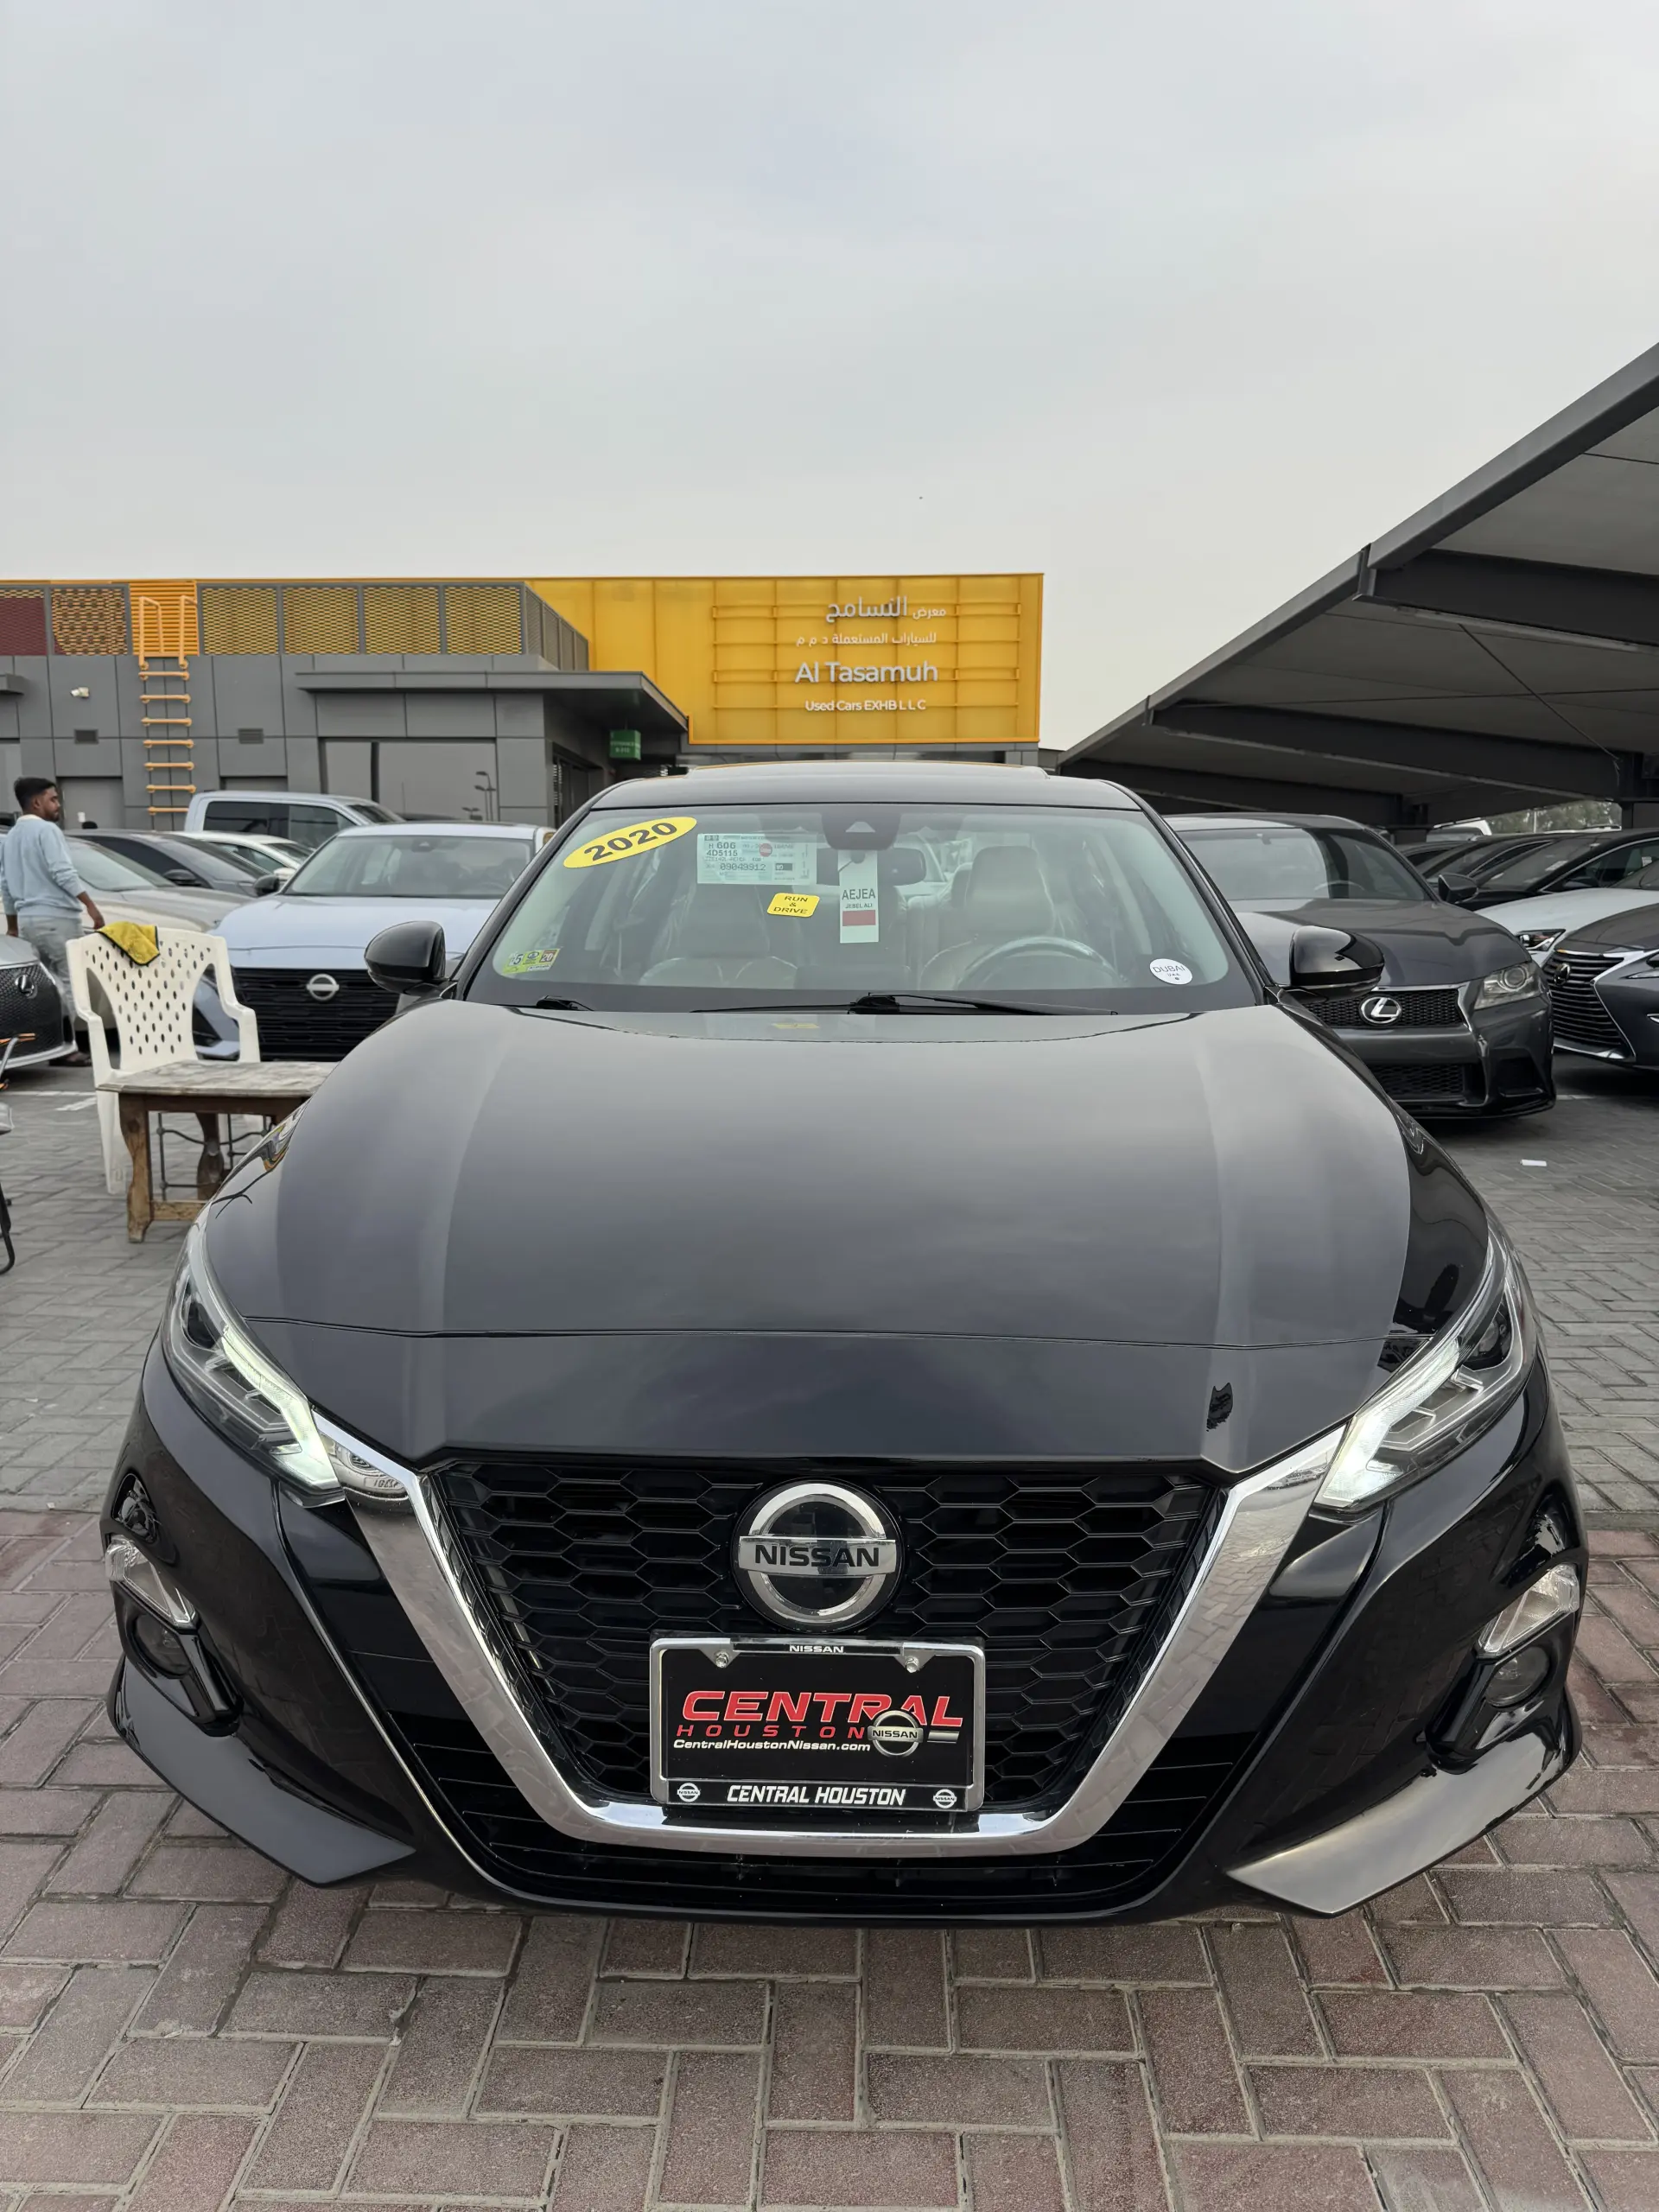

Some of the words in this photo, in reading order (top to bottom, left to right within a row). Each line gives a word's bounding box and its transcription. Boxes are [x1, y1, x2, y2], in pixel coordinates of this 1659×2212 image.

[826, 596, 907, 622] التسامح
[912, 607, 946, 620] معرض
[796, 636, 805, 647] م
[808, 636, 817, 647] م
[832, 632, 888, 645] المستعملة
[892, 632, 937, 646] للسيارات
[795, 662, 819, 683] Al
[825, 661, 938, 682] Tasamuh
[805, 700, 835, 711] Used
[836, 700, 862, 711] Cars
[864, 700, 898, 710] EXHB
[584, 823, 677, 861] 2020
[842, 888, 876, 900] AEJEA
[540, 953, 553, 962] 20
[754, 1544, 880, 1567] NISSAN
[789, 1644, 844, 1654] NISSAN
[683, 1690, 963, 1727] CENTRAL
[676, 1725, 865, 1739] HOUSTON
[873, 1730, 918, 1739] NISSAN
[673, 1739, 871, 1751] CentralHoustonNissan.com
[727, 1784, 810, 1803] CENTRAL
[815, 1786, 906, 1806] HOUSTON
